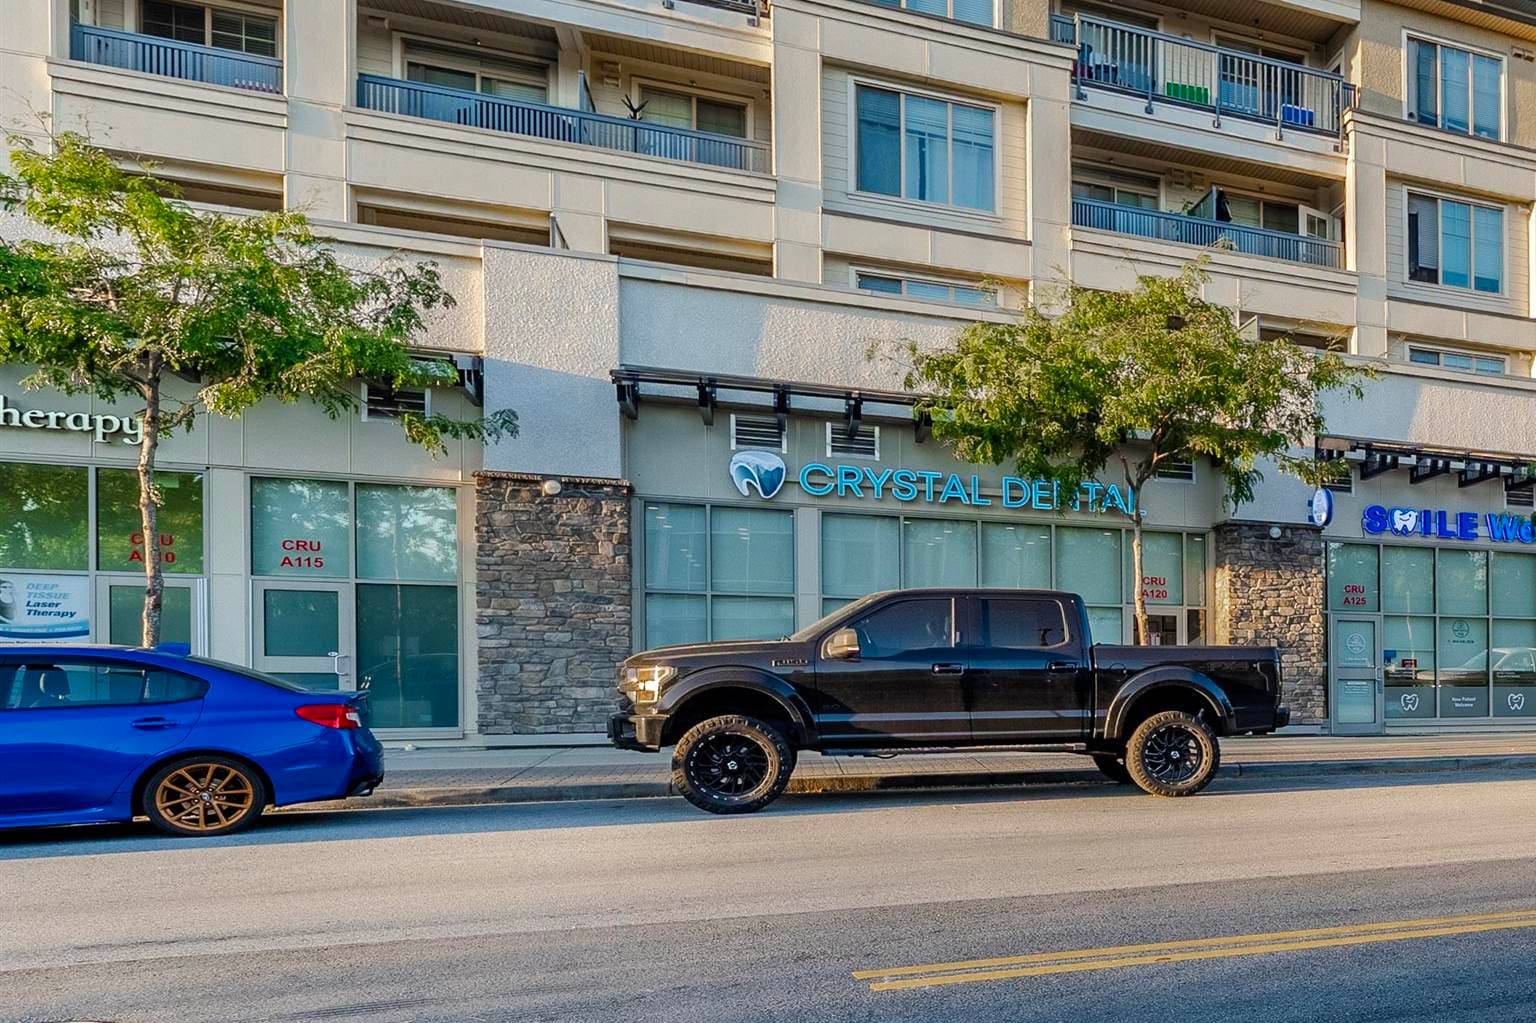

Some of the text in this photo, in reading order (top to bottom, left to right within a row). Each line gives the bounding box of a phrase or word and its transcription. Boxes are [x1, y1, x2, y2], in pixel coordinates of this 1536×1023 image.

[799, 463, 992, 506] CRYSTAL
[130, 533, 174, 546] CU
[281, 539, 322, 552] CRU
[280, 556, 324, 568] A115
[1142, 576, 1166, 585] CRU
[26, 582, 59, 591] DEEP
[1344, 585, 1365, 593] CRU
[27, 591, 71, 600] TISSUE
[1142, 589, 1168, 599] A120
[26, 600, 61, 608] Laser
[1343, 597, 1367, 605] A125
[26, 608, 77, 618] Therapy
